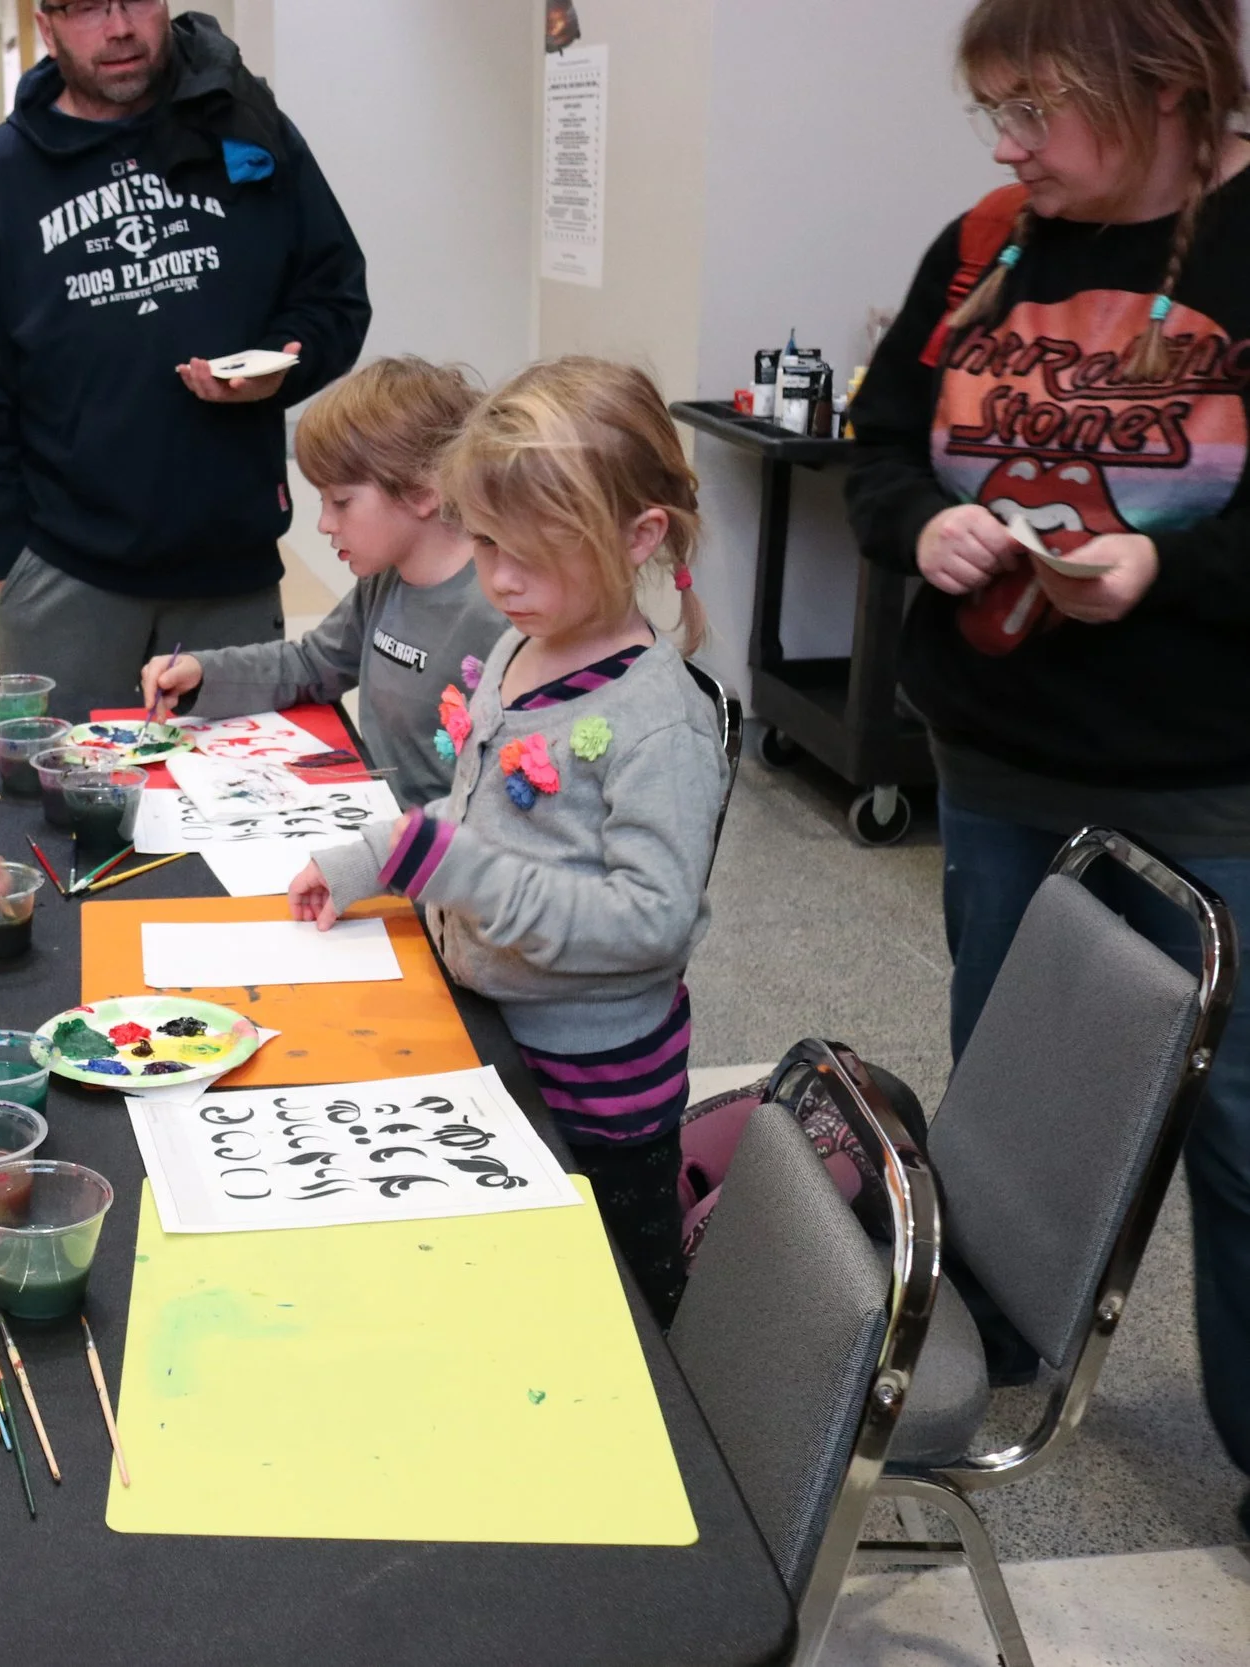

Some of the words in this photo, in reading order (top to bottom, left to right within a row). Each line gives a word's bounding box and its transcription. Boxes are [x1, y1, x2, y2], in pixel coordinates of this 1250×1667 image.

[85, 236, 114, 254] EST.
[162, 218, 190, 239] 1961
[65, 268, 115, 301] 2009
[121, 245, 221, 289] PLAYOFFS
[90, 296, 108, 307] MLB
[109, 288, 152, 303] AUTHENTIC
[153, 275, 200, 291] COLLECTION
[945, 325, 1026, 378] he
[945, 384, 1191, 469] Stones
